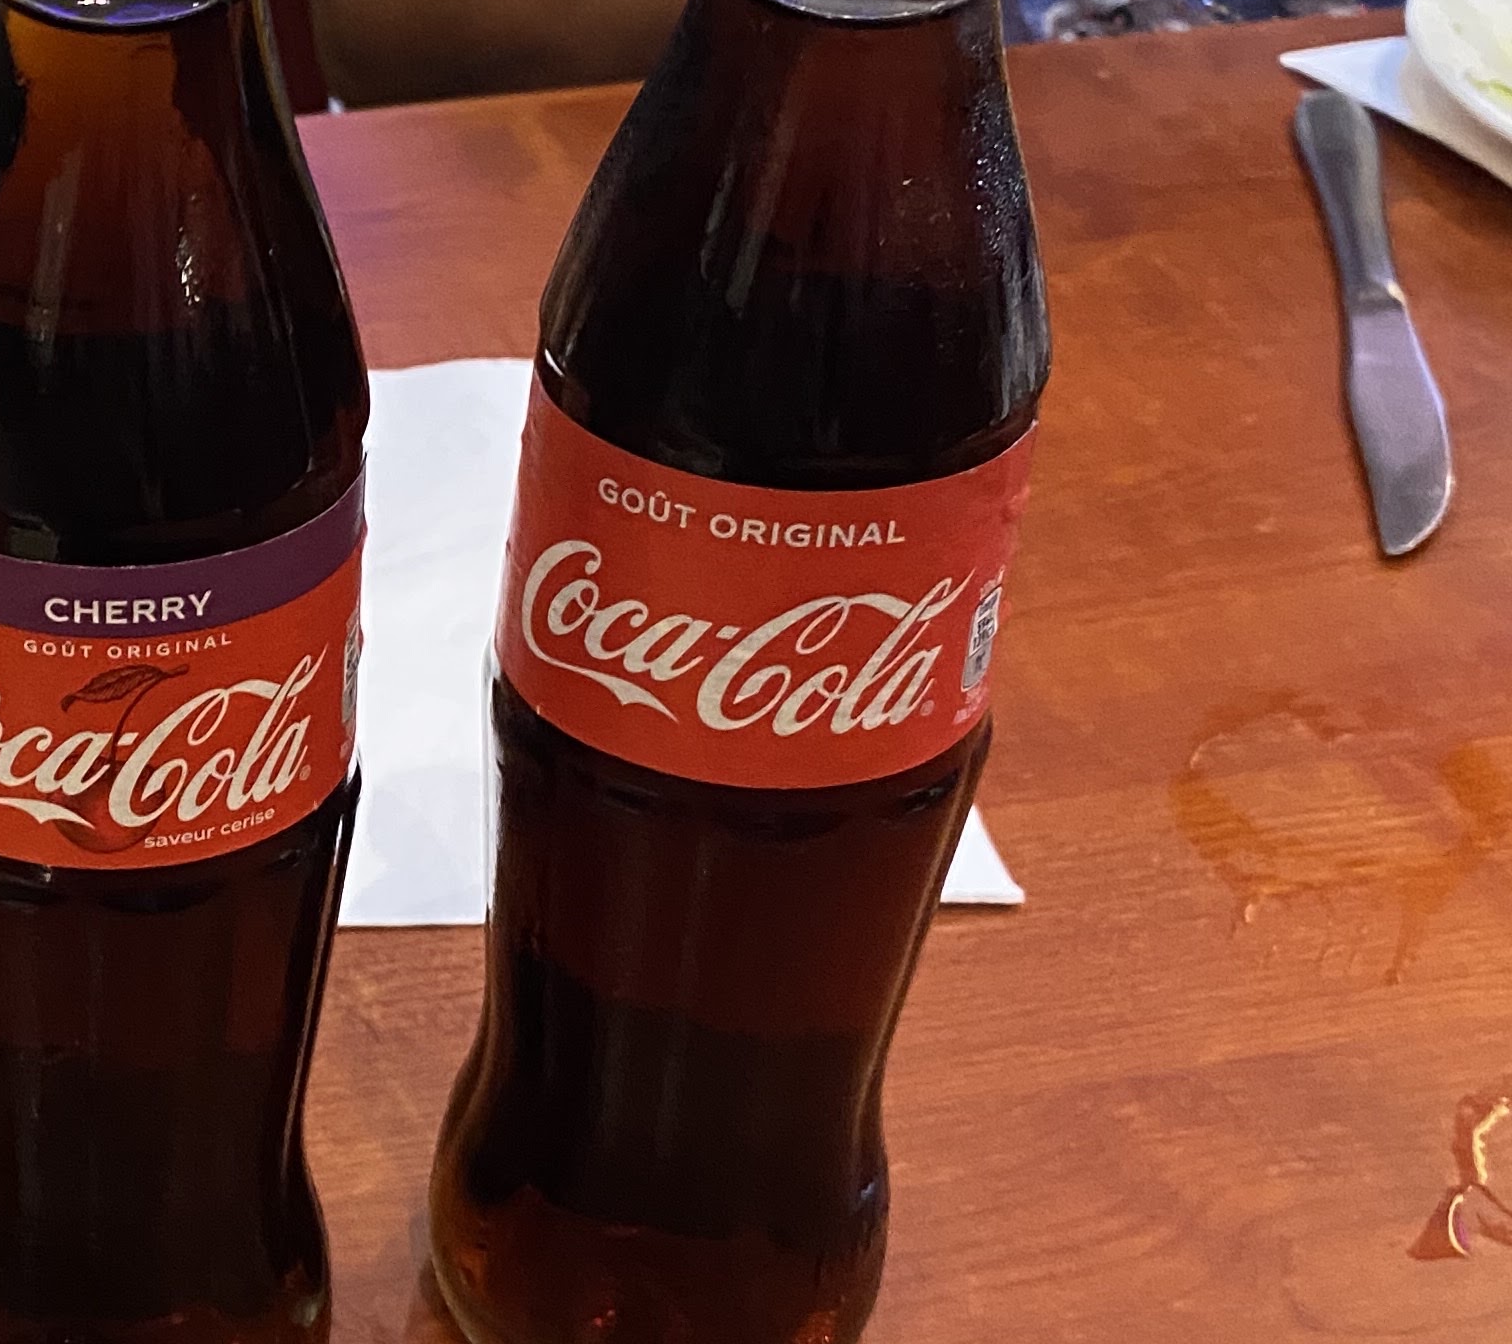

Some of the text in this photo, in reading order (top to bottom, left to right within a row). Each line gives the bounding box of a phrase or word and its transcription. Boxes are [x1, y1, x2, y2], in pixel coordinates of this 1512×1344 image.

[597, 476, 906, 549] GOÛT ORIGINAL
[44, 589, 213, 625] CHERRY
[23, 633, 233, 660] GOÛT ORIGINAL
[521, 539, 977, 737] Coca-Cola
[143, 805, 276, 850] saveur cerise
